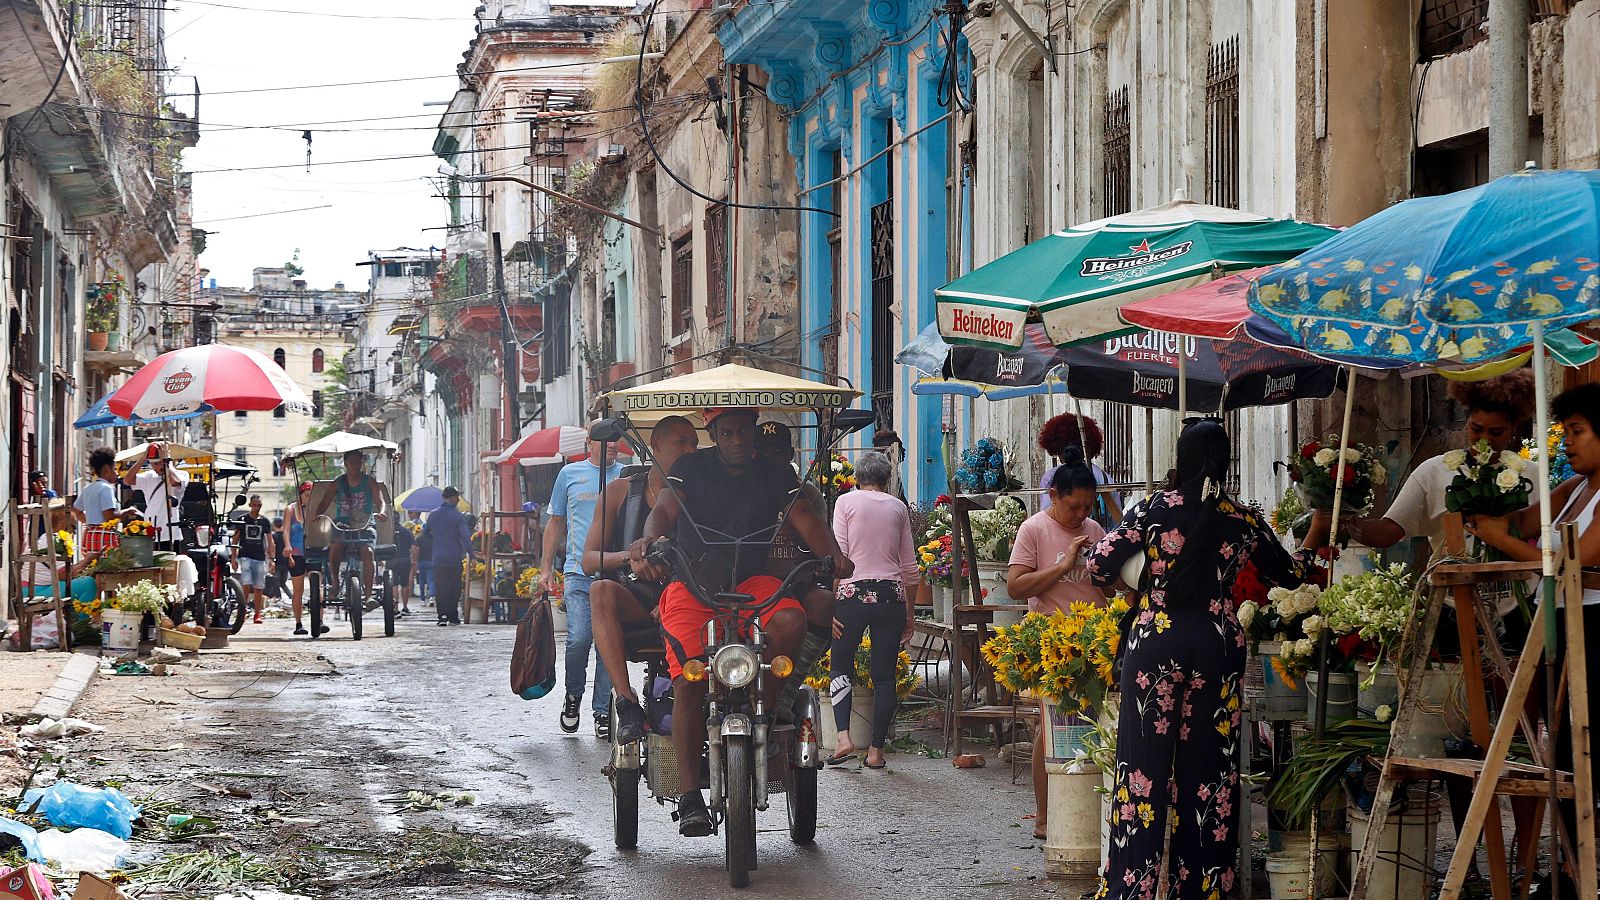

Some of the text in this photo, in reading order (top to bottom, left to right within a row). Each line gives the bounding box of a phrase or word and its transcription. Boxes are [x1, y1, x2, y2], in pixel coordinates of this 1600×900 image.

[1089, 246, 1185, 273] Heineken
[952, 308, 1014, 340] Heineken
[996, 352, 1024, 378] Bucanero
[1127, 351, 1173, 364] FUERTE
[162, 375, 197, 385] Havana
[166, 382, 187, 391] Club
[1132, 370, 1174, 395] Bucanero
[1264, 373, 1296, 398] Bucanero
[626, 391, 843, 409] TU TORMENTO SOY YO
